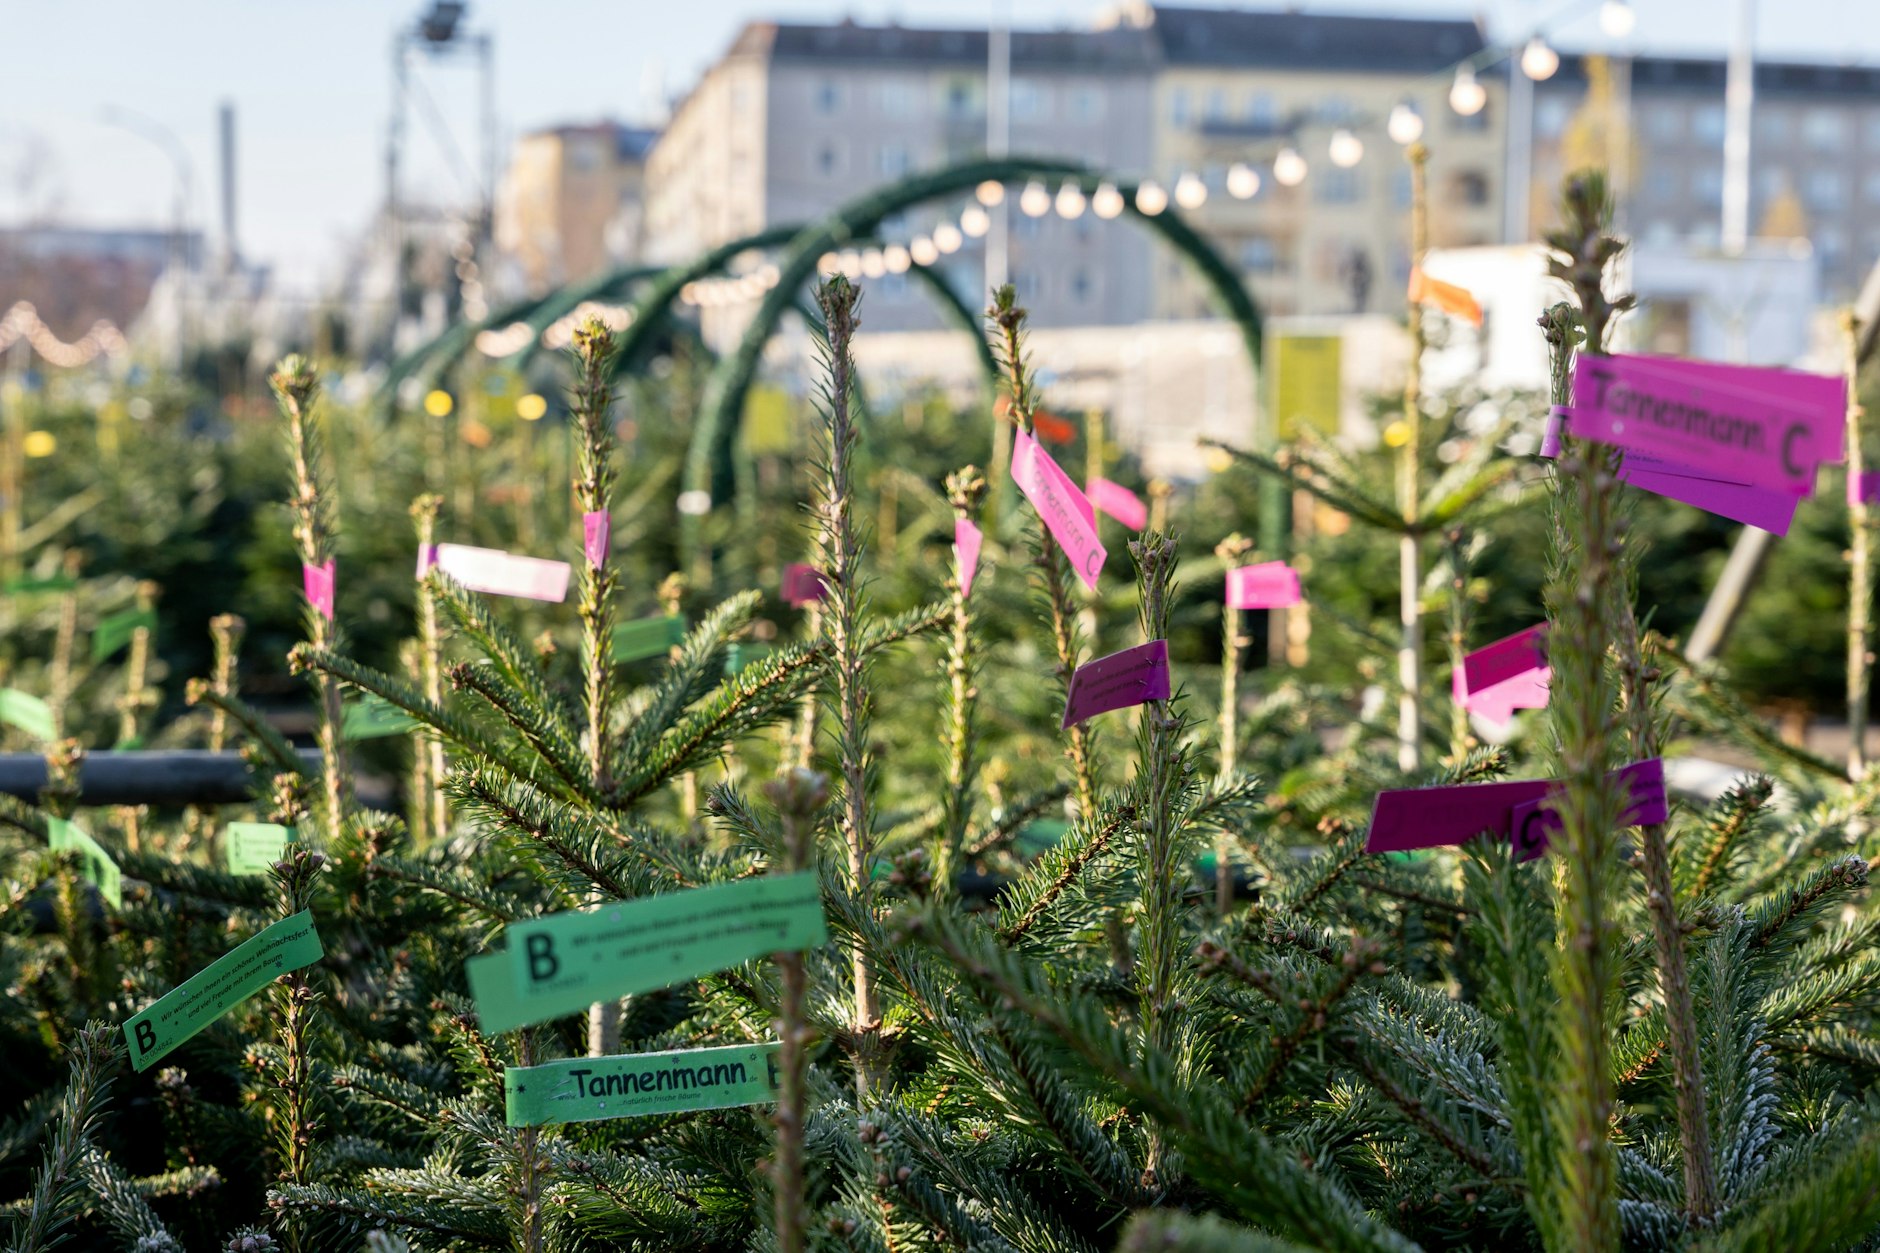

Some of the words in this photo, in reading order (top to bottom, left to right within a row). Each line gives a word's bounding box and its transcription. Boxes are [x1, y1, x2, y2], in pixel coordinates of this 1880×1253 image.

[1781, 421, 1811, 477] C
[1520, 810, 1543, 849] C
[174, 990, 203, 1014] wünschen
[221, 971, 231, 982] ein
[232, 956, 255, 974] schönes
[256, 928, 309, 958] Weihnachtsfest
[526, 932, 560, 982] B
[188, 1006, 200, 1019] und
[201, 999, 212, 1011] viel
[212, 985, 233, 1003] Freude
[233, 976, 244, 989] mit
[263, 952, 283, 968] Baum
[134, 1019, 157, 1056] B
[569, 1062, 746, 1099] Tannenmann
[653, 1093, 677, 1105] frische
[678, 1091, 702, 1101] Bäume
